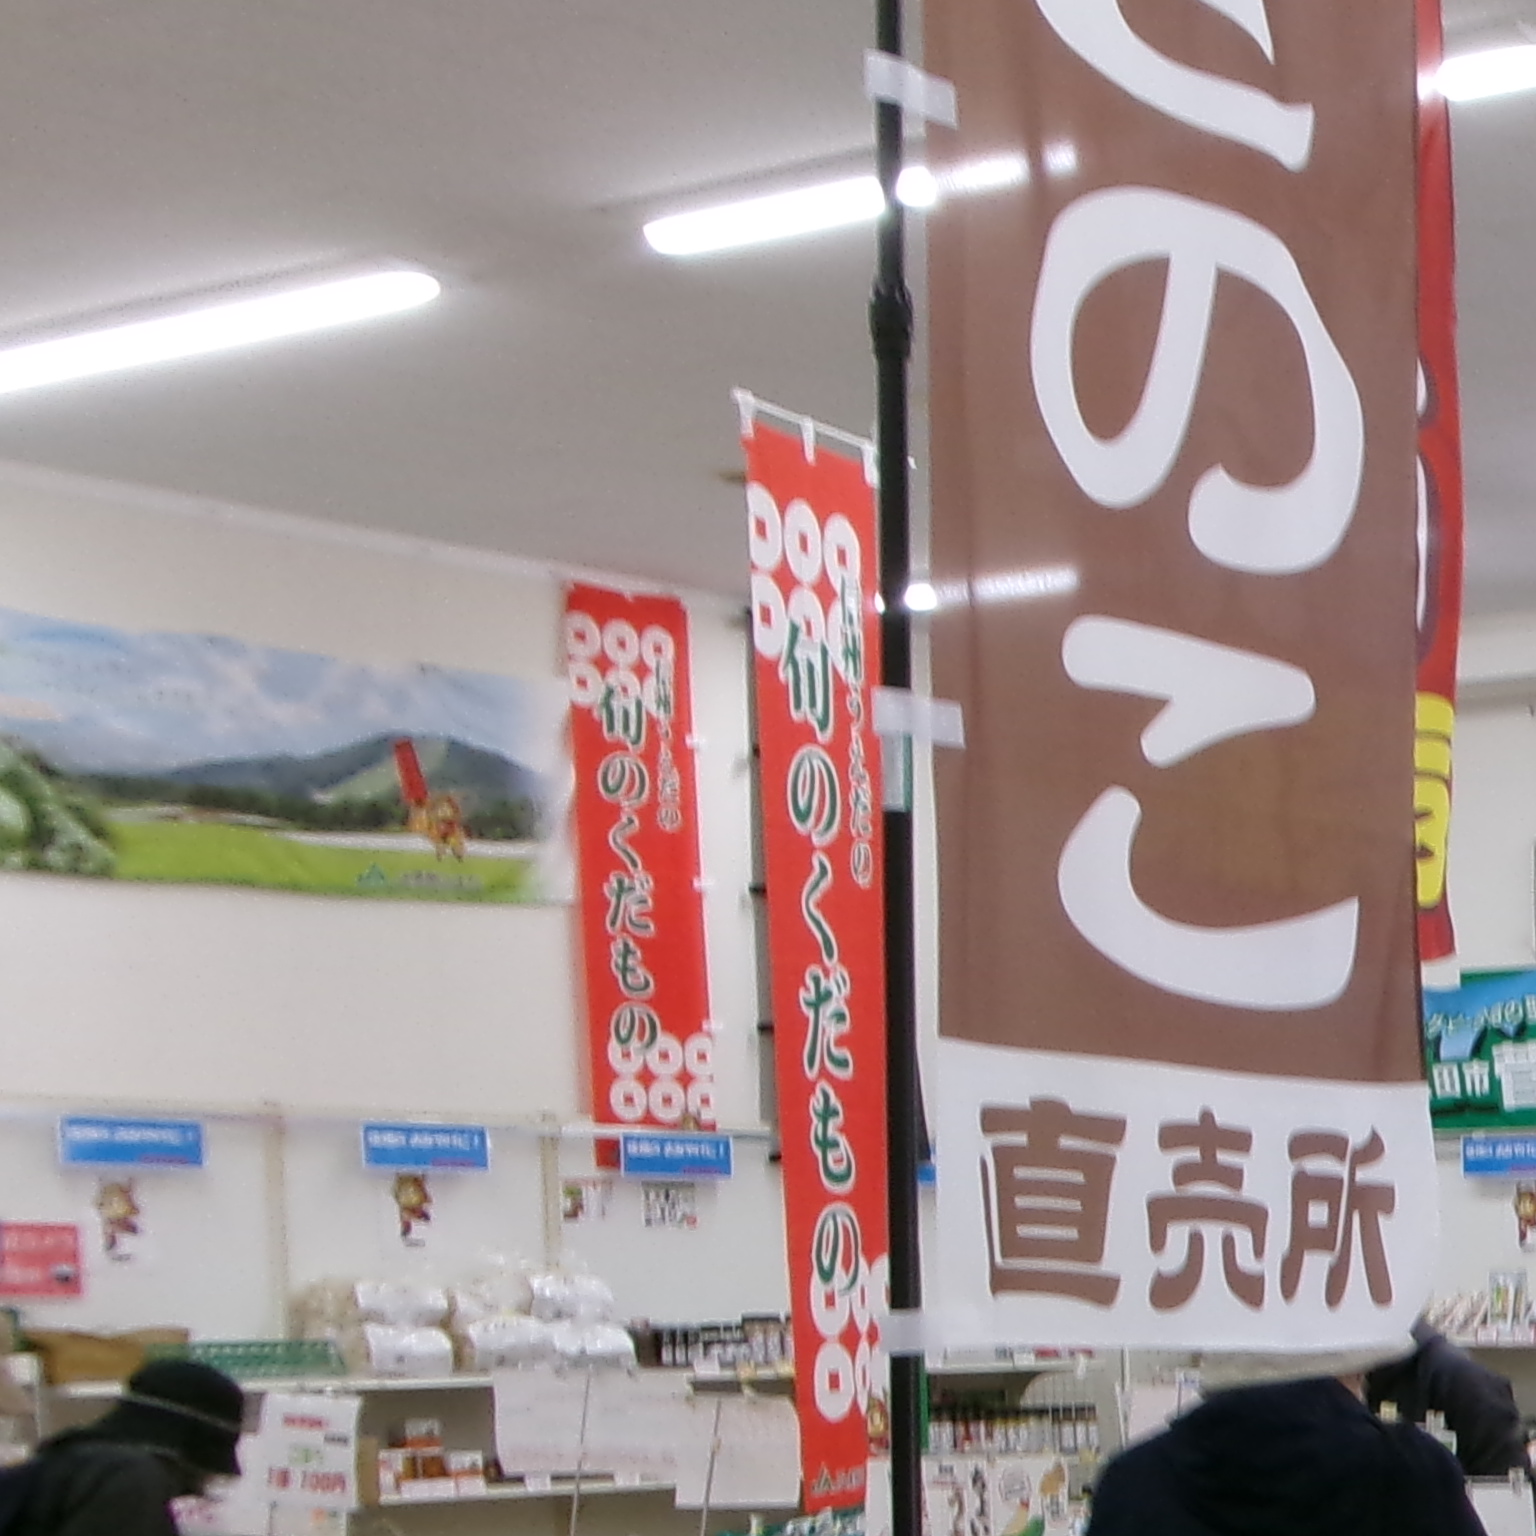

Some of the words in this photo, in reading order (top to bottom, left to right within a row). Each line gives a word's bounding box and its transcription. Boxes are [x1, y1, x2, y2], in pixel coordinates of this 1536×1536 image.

[600, 678, 660, 1054] 旬のくだもの
[776, 613, 863, 1295] 旬のくだもの
[979, 1099, 1397, 1312] 直売所
